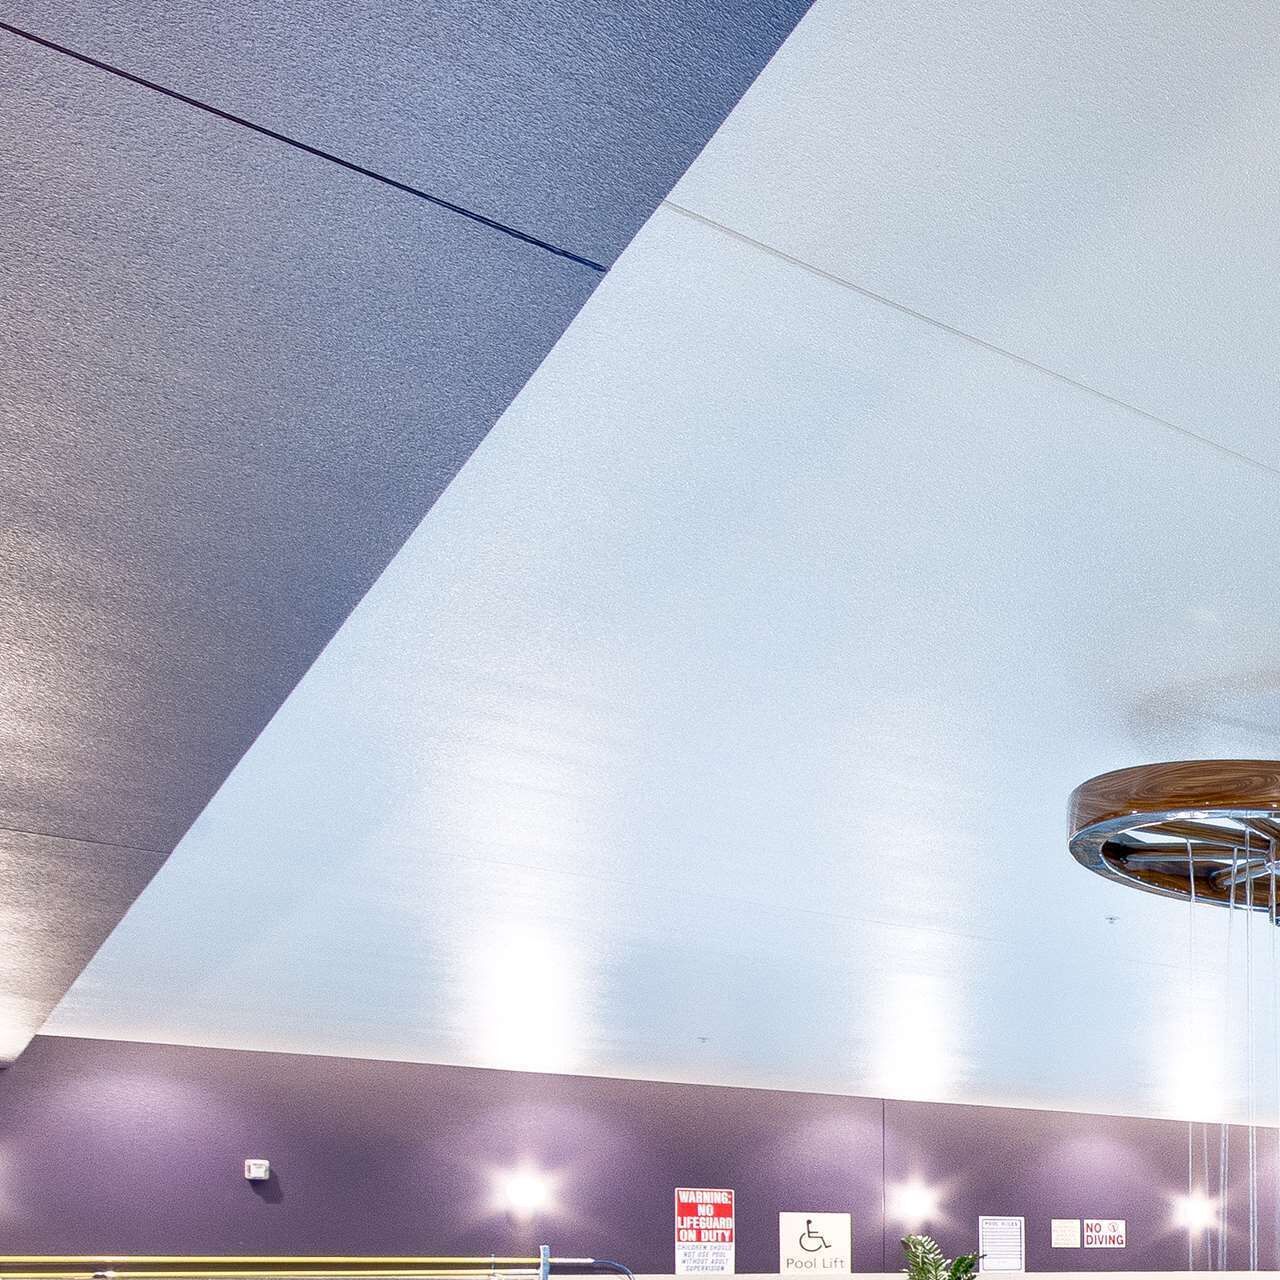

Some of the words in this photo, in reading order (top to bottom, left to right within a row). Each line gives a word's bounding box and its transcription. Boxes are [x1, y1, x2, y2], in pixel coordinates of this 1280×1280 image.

[679, 1190, 732, 1204] WARNING:
[698, 1204, 714, 1216] NO
[677, 1216, 733, 1229] LIFEGUARD
[1086, 1222, 1102, 1233] NO
[679, 1229, 697, 1241] ON
[701, 1230, 731, 1241] DUTY
[1086, 1234, 1124, 1245] DIVING
[786, 1258, 816, 1269] Pool
[822, 1257, 846, 1269] Lift
